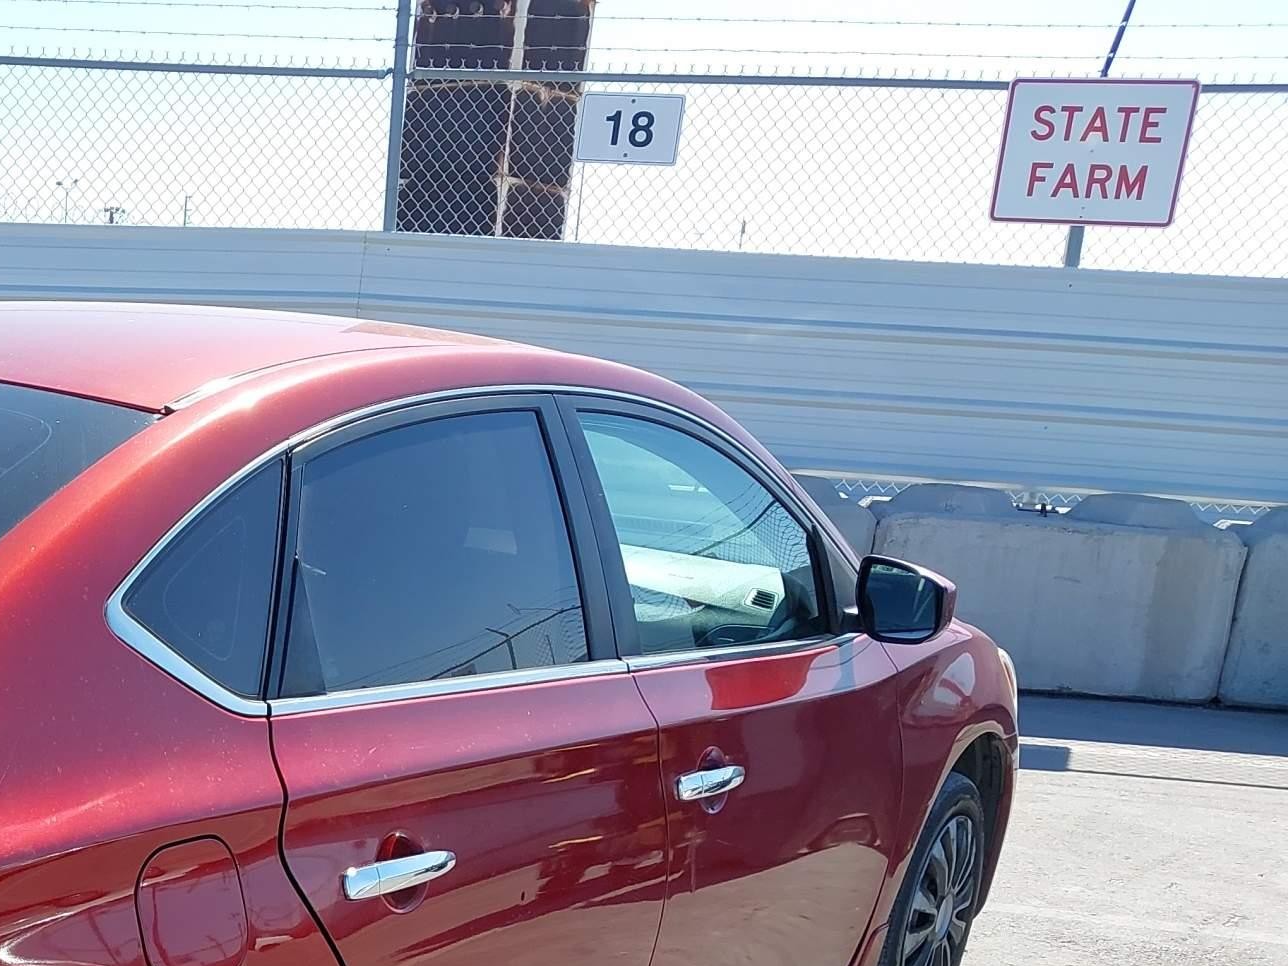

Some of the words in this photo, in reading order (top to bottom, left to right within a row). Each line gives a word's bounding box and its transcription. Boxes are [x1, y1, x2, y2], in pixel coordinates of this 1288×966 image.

[605, 110, 655, 148] 18
[1030, 104, 1168, 144] STATE
[1026, 162, 1149, 201] FARM
